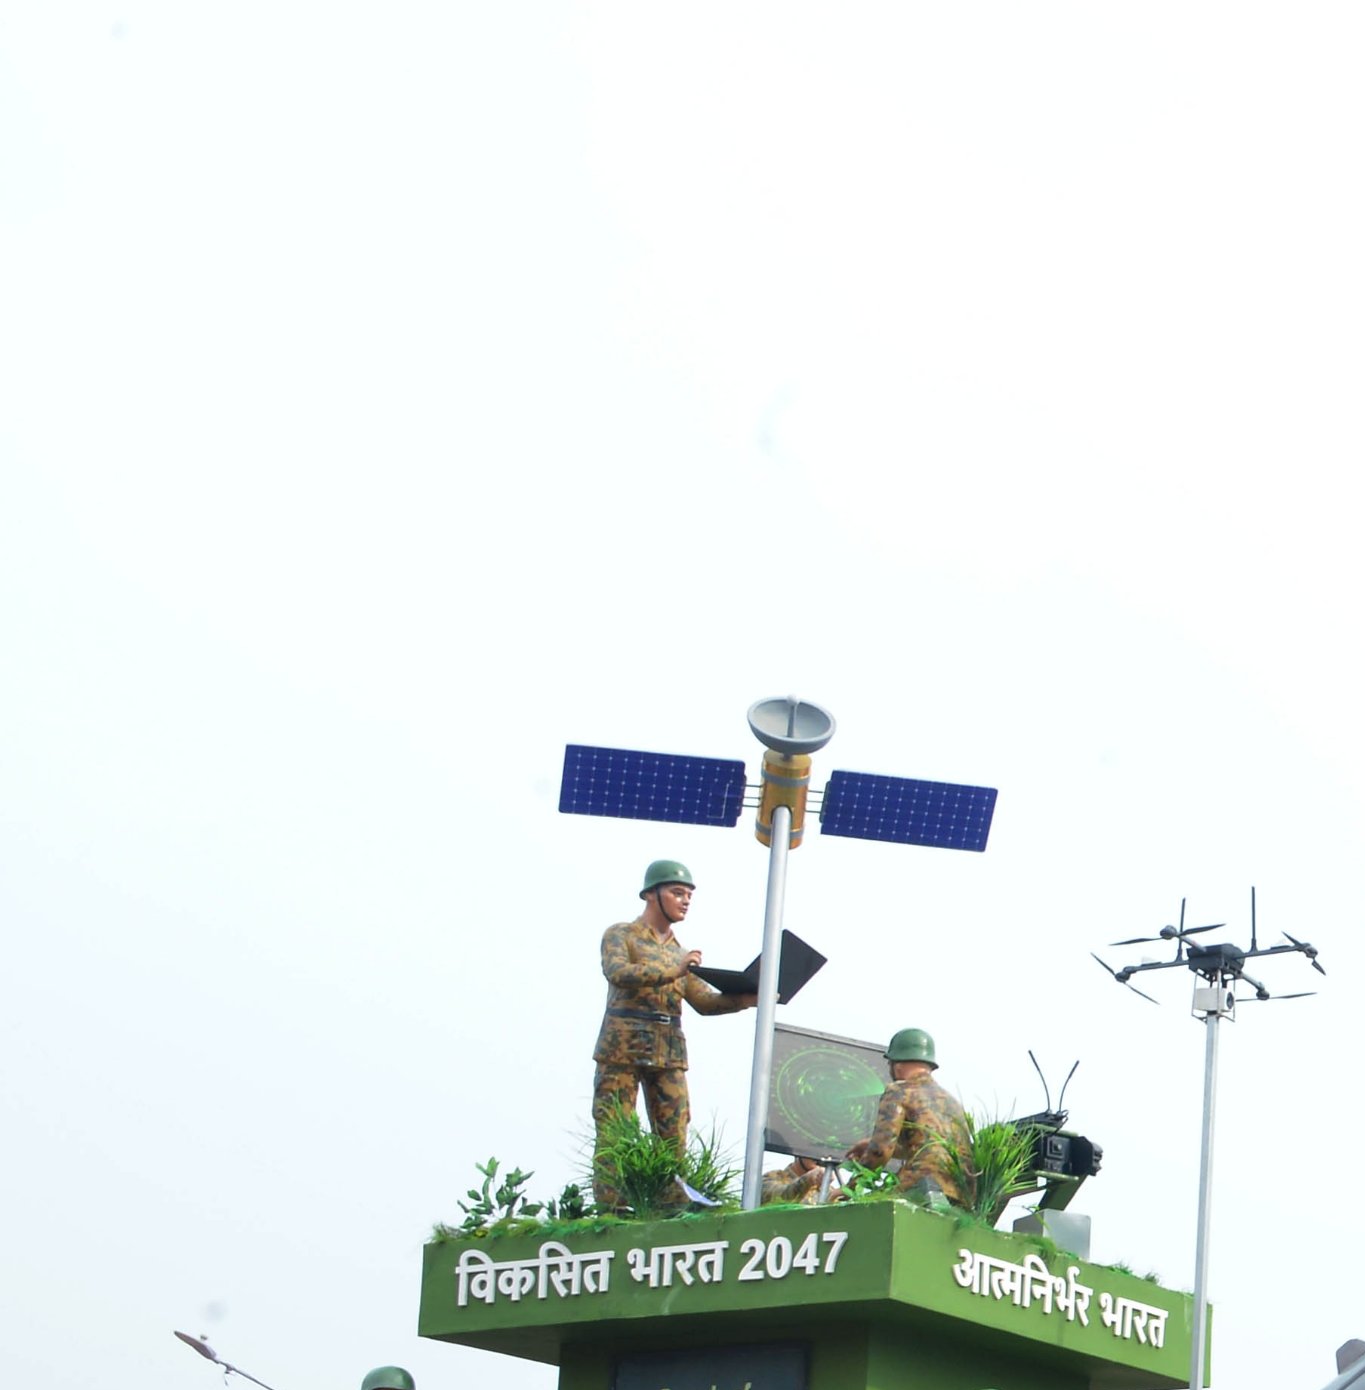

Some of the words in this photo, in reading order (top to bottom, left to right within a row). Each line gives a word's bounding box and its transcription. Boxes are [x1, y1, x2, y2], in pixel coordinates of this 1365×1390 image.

[455, 1241, 615, 1306] विकसित
[626, 1240, 729, 1288] भारत
[738, 1231, 848, 1281] 2047
[953, 1248, 1093, 1327] आत्मनिर्भर
[1099, 1292, 1168, 1348] भारत
